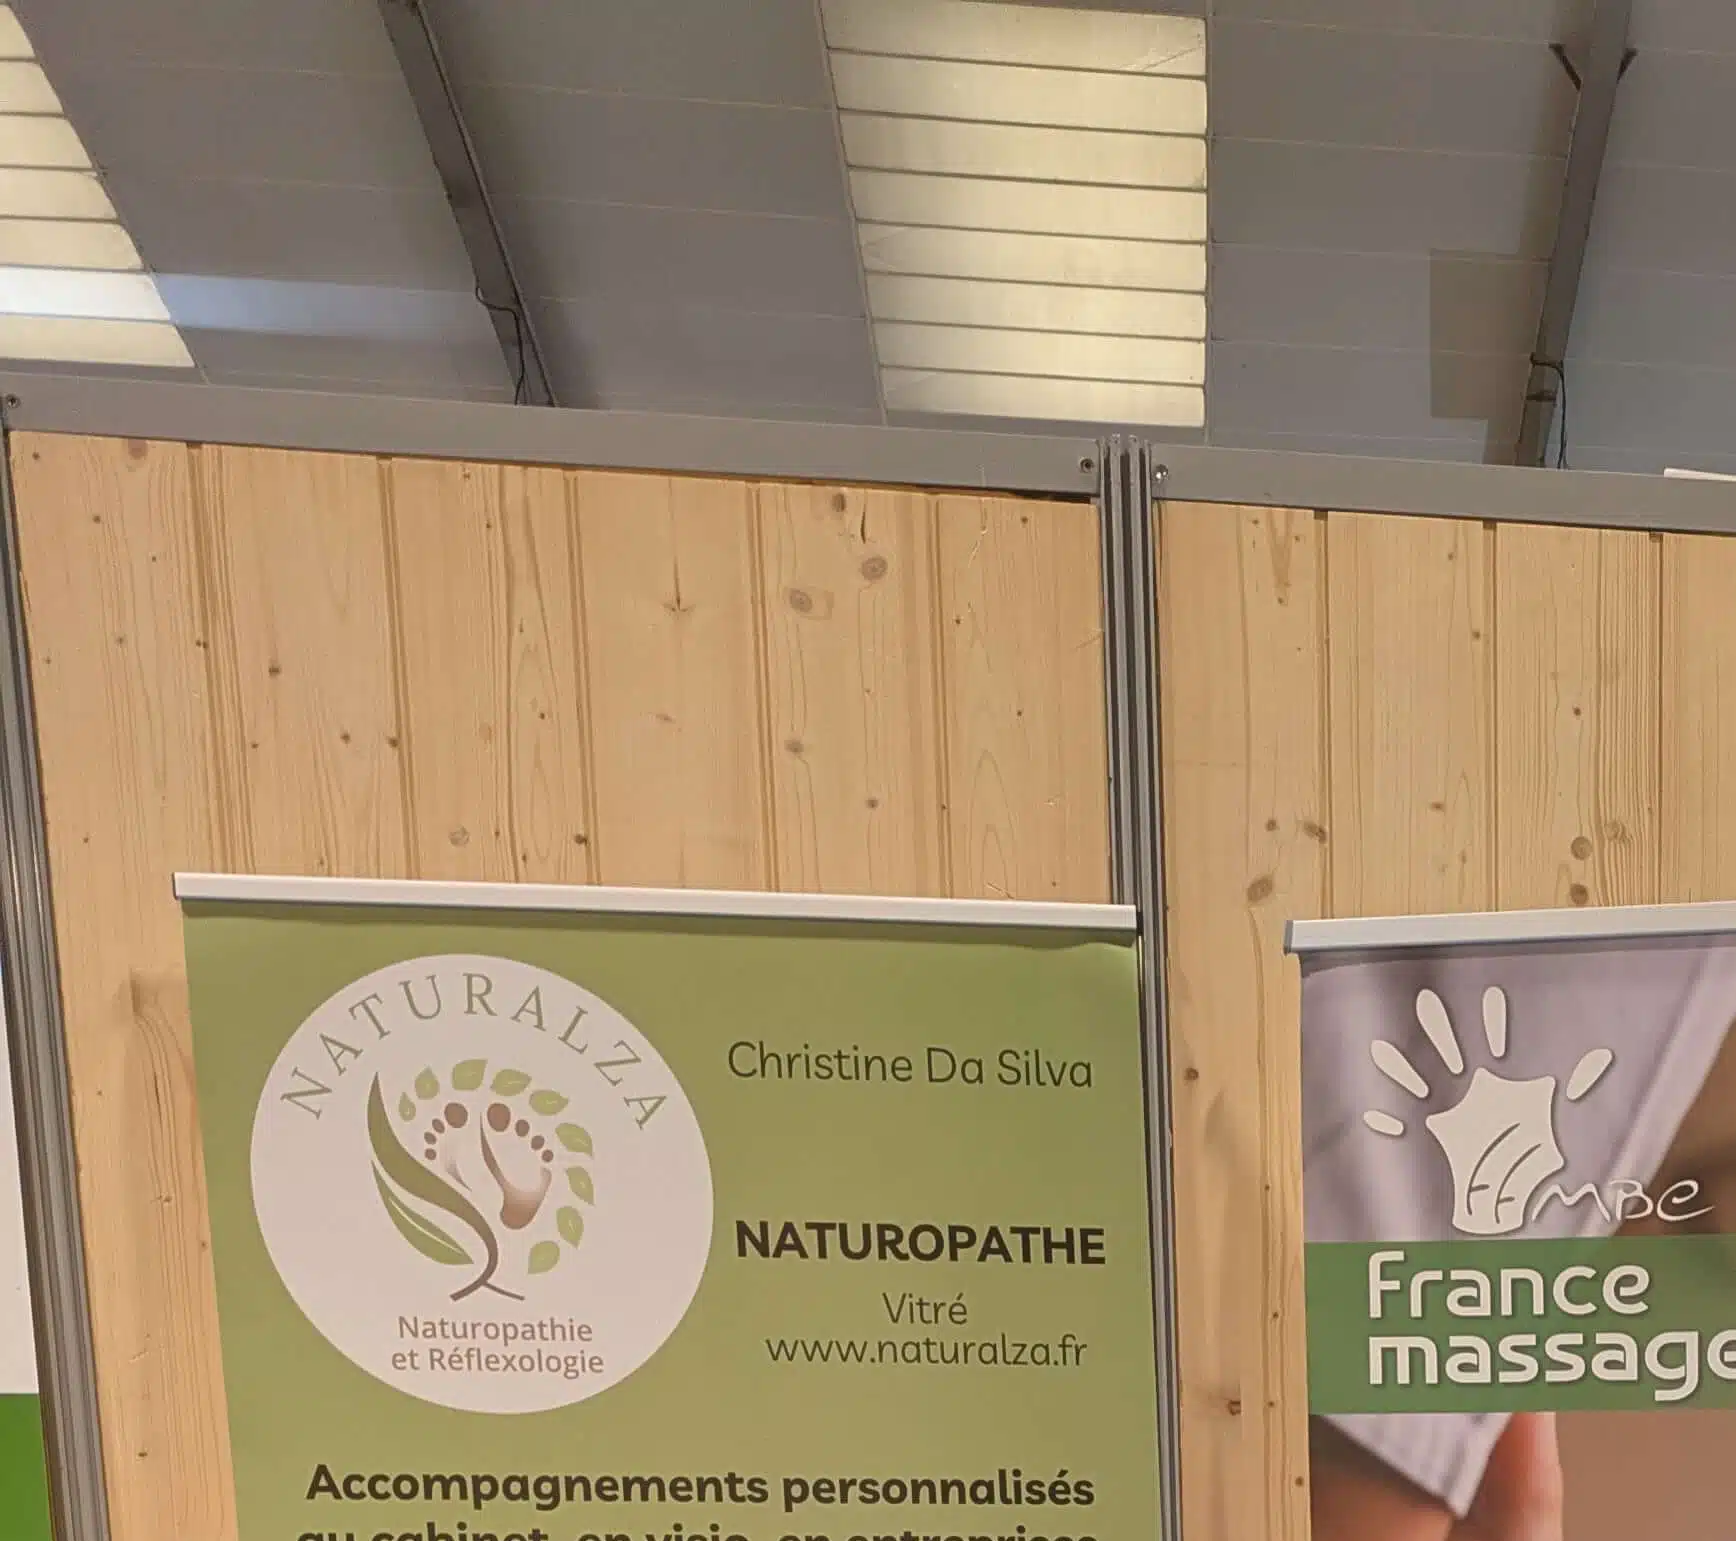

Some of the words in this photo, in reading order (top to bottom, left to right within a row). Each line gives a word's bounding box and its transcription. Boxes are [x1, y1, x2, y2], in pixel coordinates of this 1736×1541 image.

[280, 970, 668, 1133] NATURALZA
[729, 1041, 912, 1082] Christine
[927, 1048, 983, 1084] Da
[998, 1049, 1091, 1088] Silva
[736, 1221, 1105, 1264] NATUROPATHE
[882, 1293, 967, 1325] Vitré
[399, 1316, 592, 1347] Naturopathie
[766, 1333, 1087, 1366] www.naturalza.fr
[392, 1349, 420, 1370] et
[429, 1347, 604, 1379] Réflexologie
[306, 1464, 768, 1511] Accompagnements
[783, 1469, 1094, 1512] personnalisés
